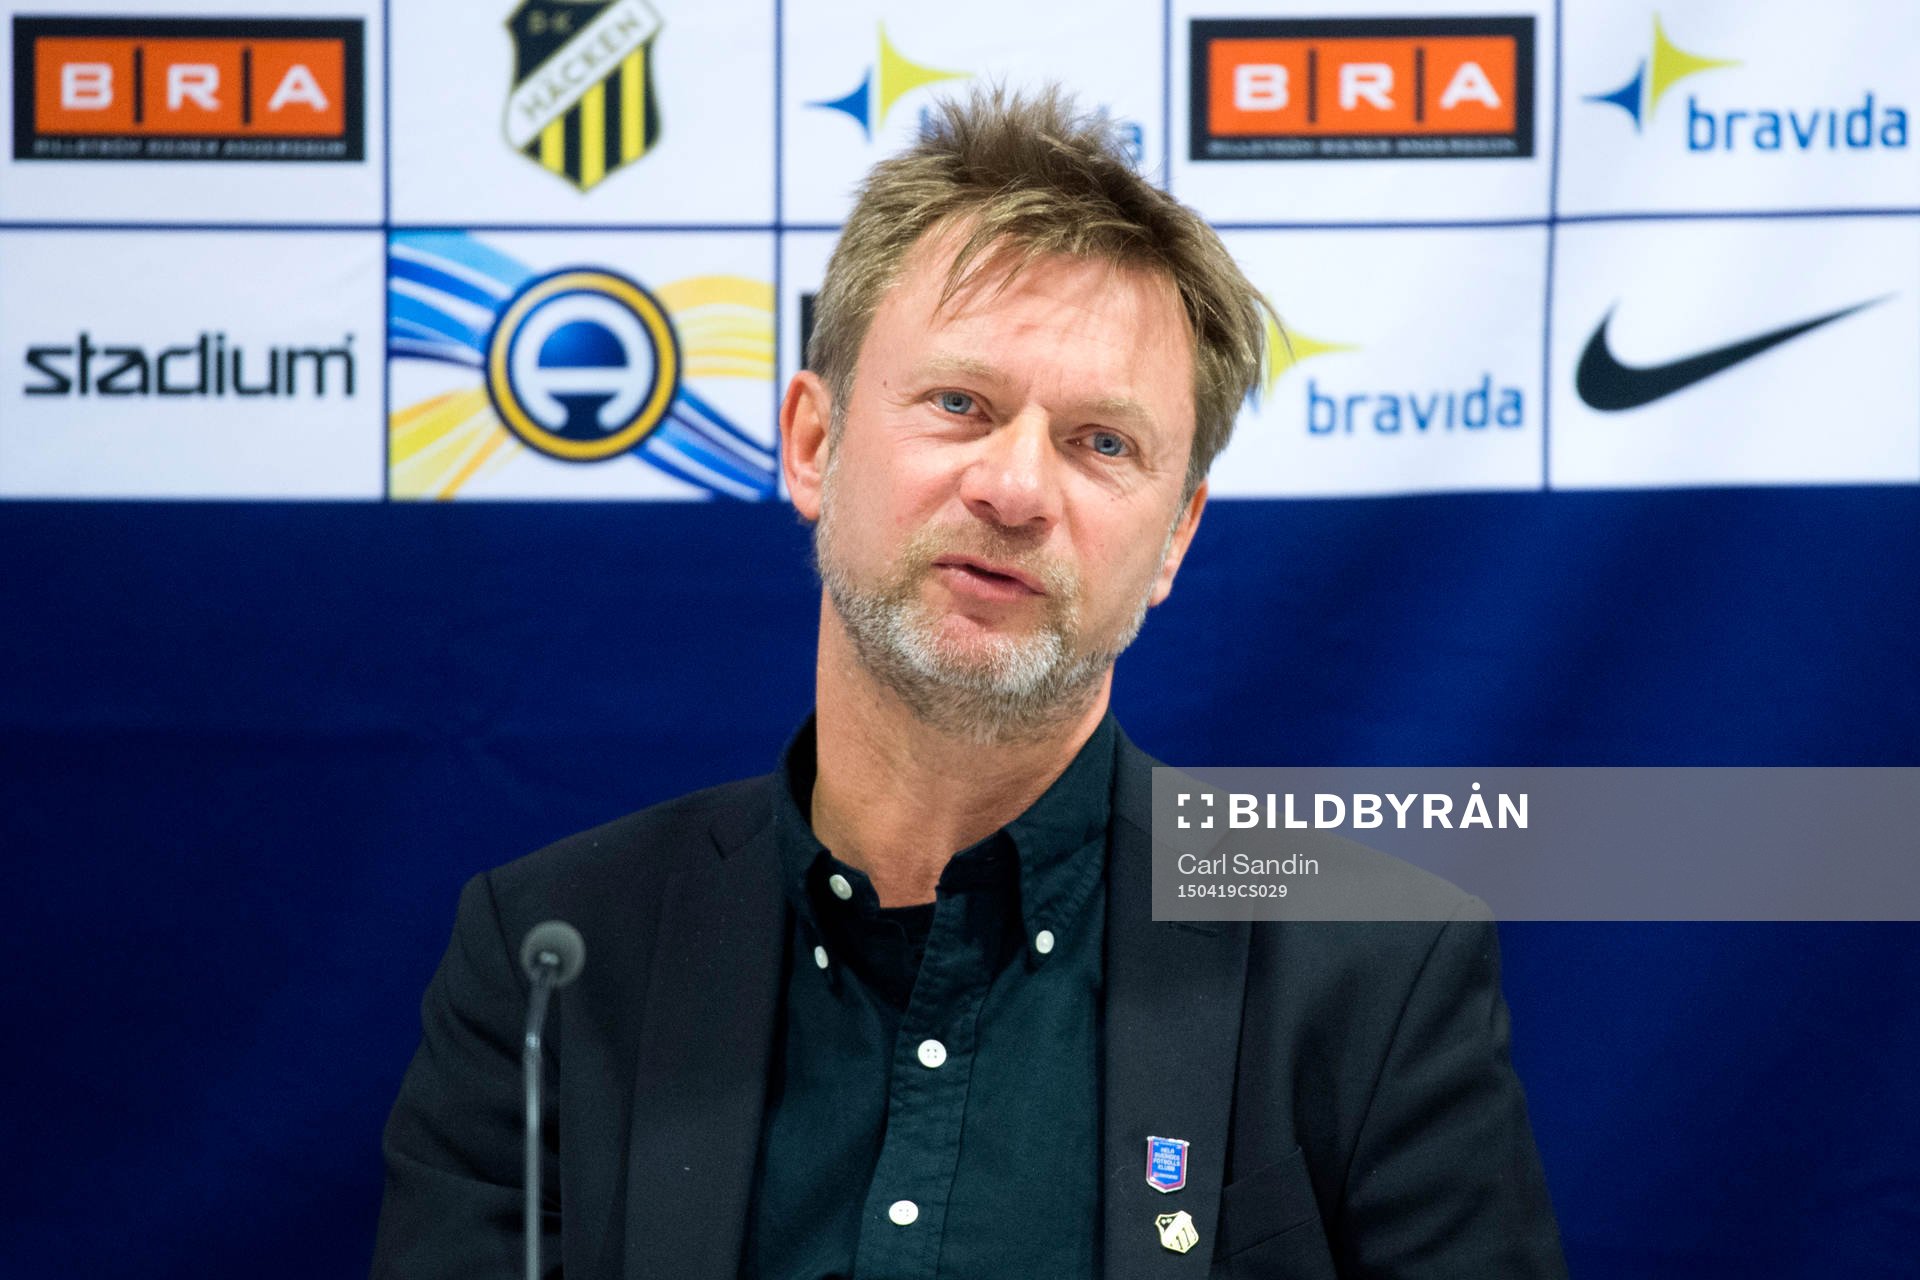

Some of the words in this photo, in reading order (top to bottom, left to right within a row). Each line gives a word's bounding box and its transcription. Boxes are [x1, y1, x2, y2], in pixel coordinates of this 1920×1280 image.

[60, 62, 330, 112] BRA
[1233, 60, 1503, 112] BRA
[1685, 92, 1909, 151] bravida
[24, 331, 357, 397] stadium
[1307, 372, 1524, 435] bravida
